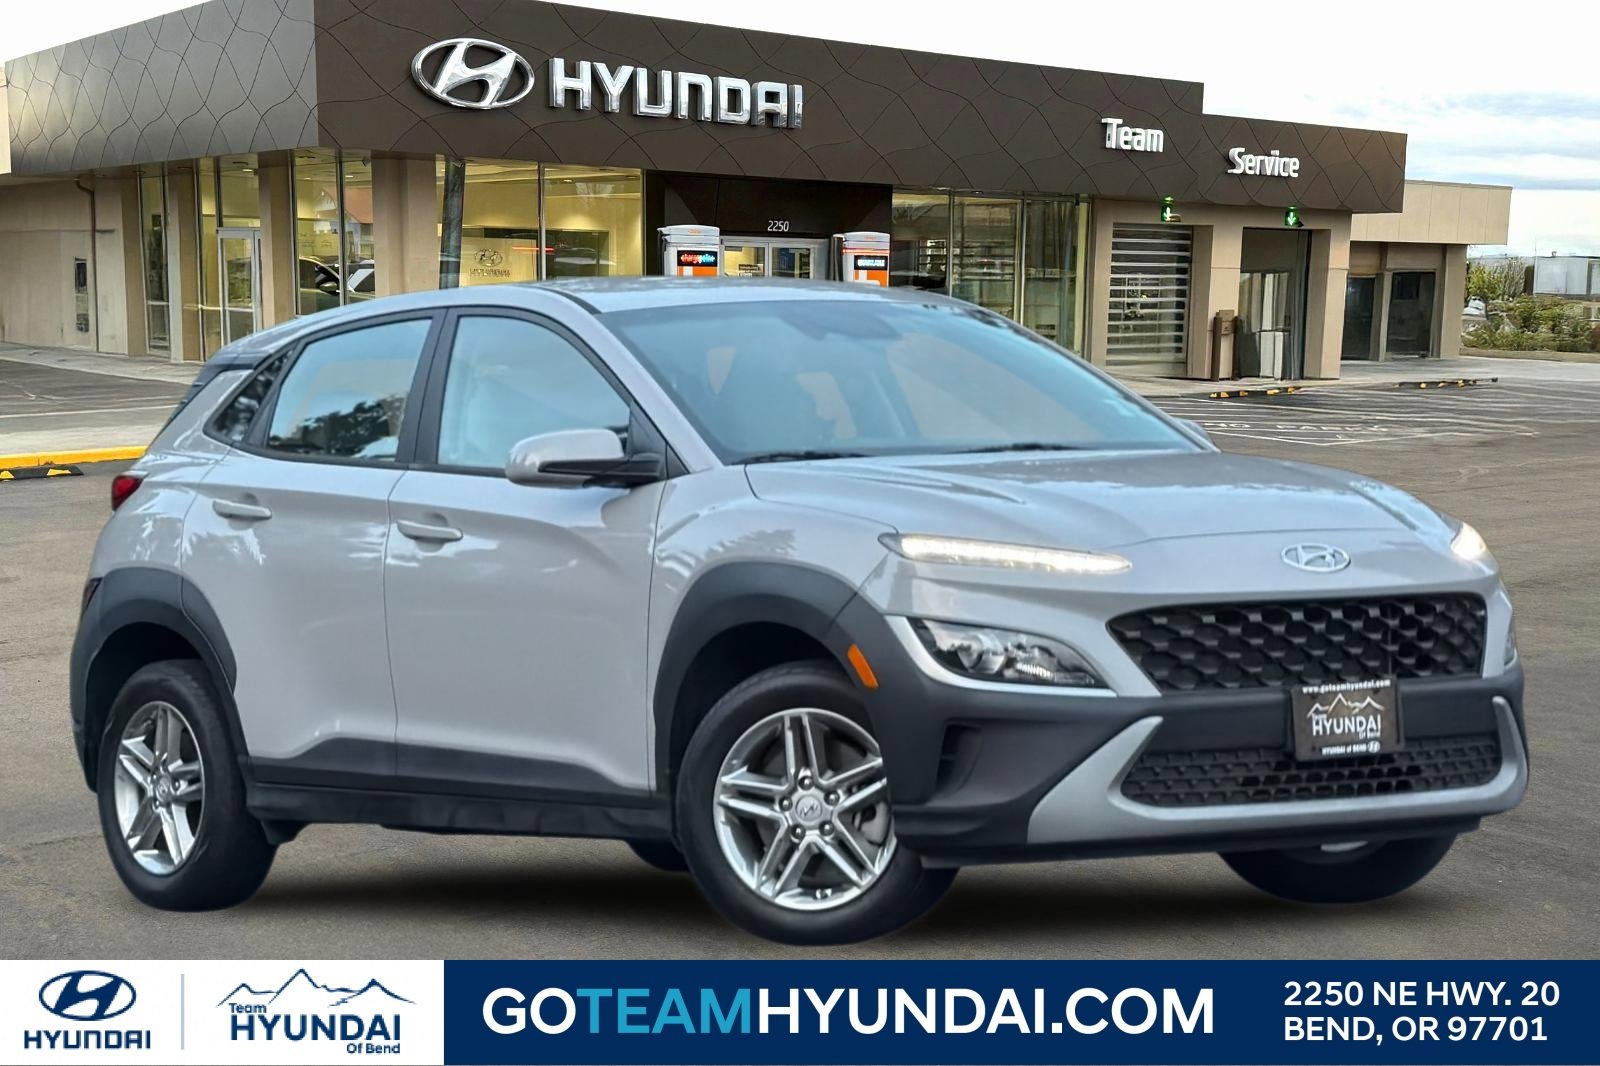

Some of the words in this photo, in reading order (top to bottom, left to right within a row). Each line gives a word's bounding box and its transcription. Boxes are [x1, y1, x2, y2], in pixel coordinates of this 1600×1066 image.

[548, 57, 804, 130] HYUNDAI
[1101, 117, 1164, 153] Team
[1227, 147, 1300, 178] Service
[767, 220, 790, 232] 2250
[1312, 714, 1381, 736] HYUNDAI
